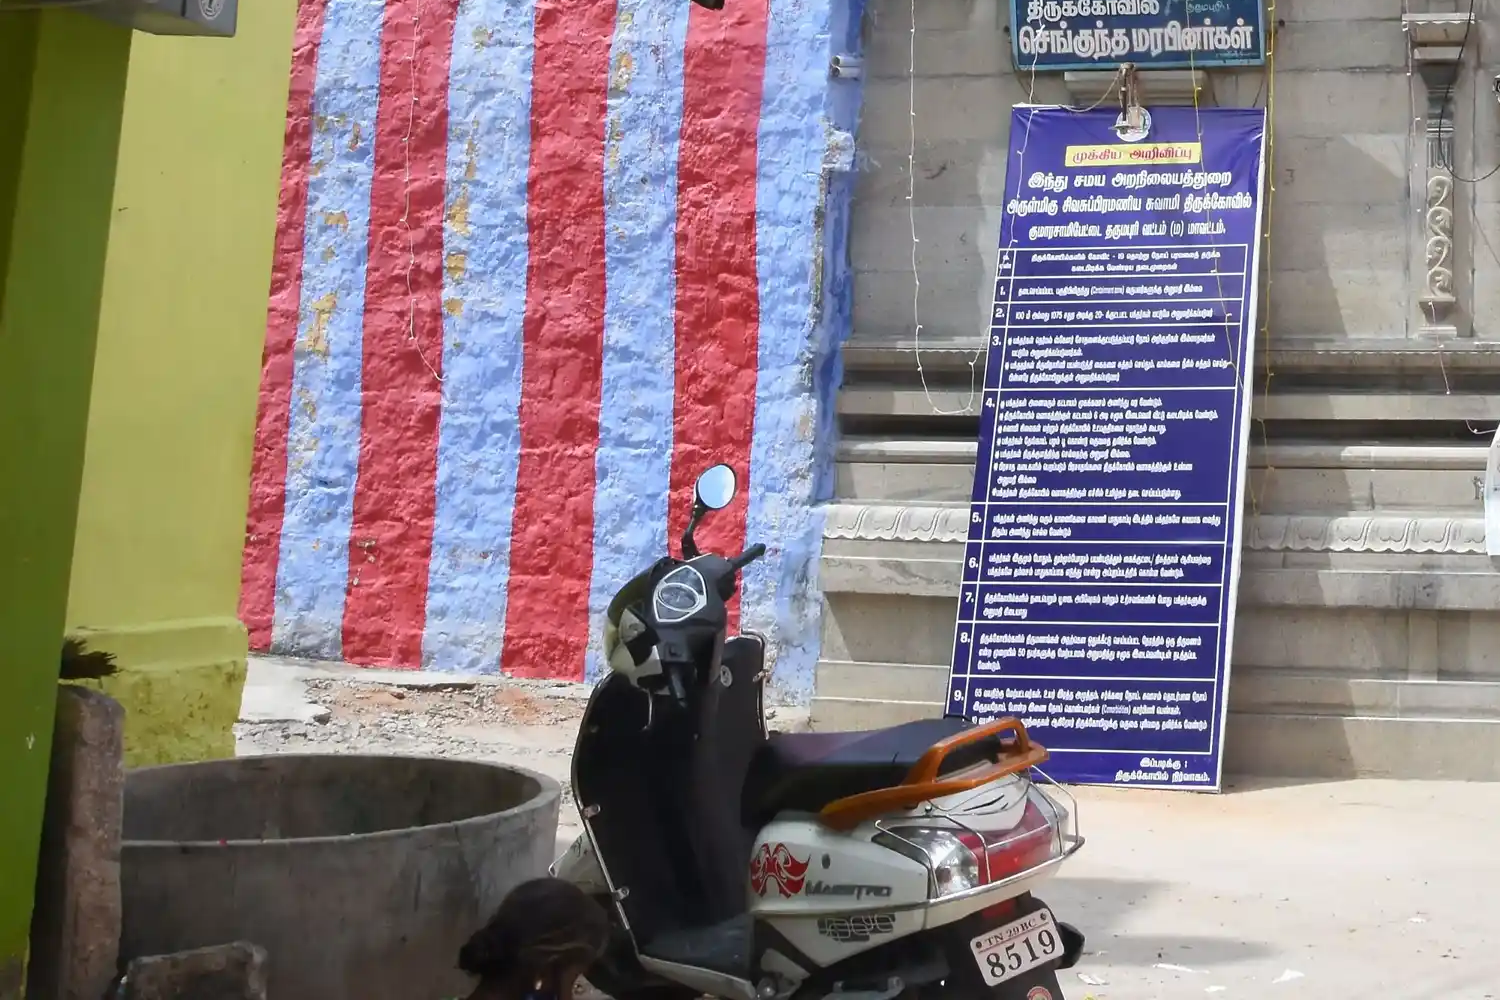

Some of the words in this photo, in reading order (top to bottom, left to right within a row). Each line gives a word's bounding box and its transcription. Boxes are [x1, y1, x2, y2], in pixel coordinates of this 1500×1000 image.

[1020, 20, 1129, 60] செங்குந்த
[1133, 19, 1253, 58] மரபினர்கள்
[1073, 148, 1123, 163] முக்கிய
[1129, 147, 1193, 161] அறிவிப்பு
[1028, 172, 1068, 192] இந்து
[1073, 174, 1106, 188] சமய
[1111, 169, 1232, 190] அறநிலையத்துறை
[1007, 195, 1058, 217] அருள்மிகு
[1146, 194, 1180, 211] சுவாமி
[1183, 192, 1252, 214] திருக்கோவில்
[1028, 222, 1102, 240] குமாரசாமிபேட்டை
[1142, 220, 1167, 237] வட்டம்
[1000, 285, 1007, 295] 1.
[995, 307, 1005, 318] 2.
[992, 336, 1001, 346] 3.
[986, 397, 995, 408] 4.
[972, 512, 982, 523] 5.
[968, 557, 979, 568] 6.
[965, 592, 974, 603] 7.
[960, 632, 970, 643] 8.
[954, 690, 965, 702] 9.
[1140, 757, 1181, 771] இப்படிக்கு
[986, 929, 1056, 978] 8519
